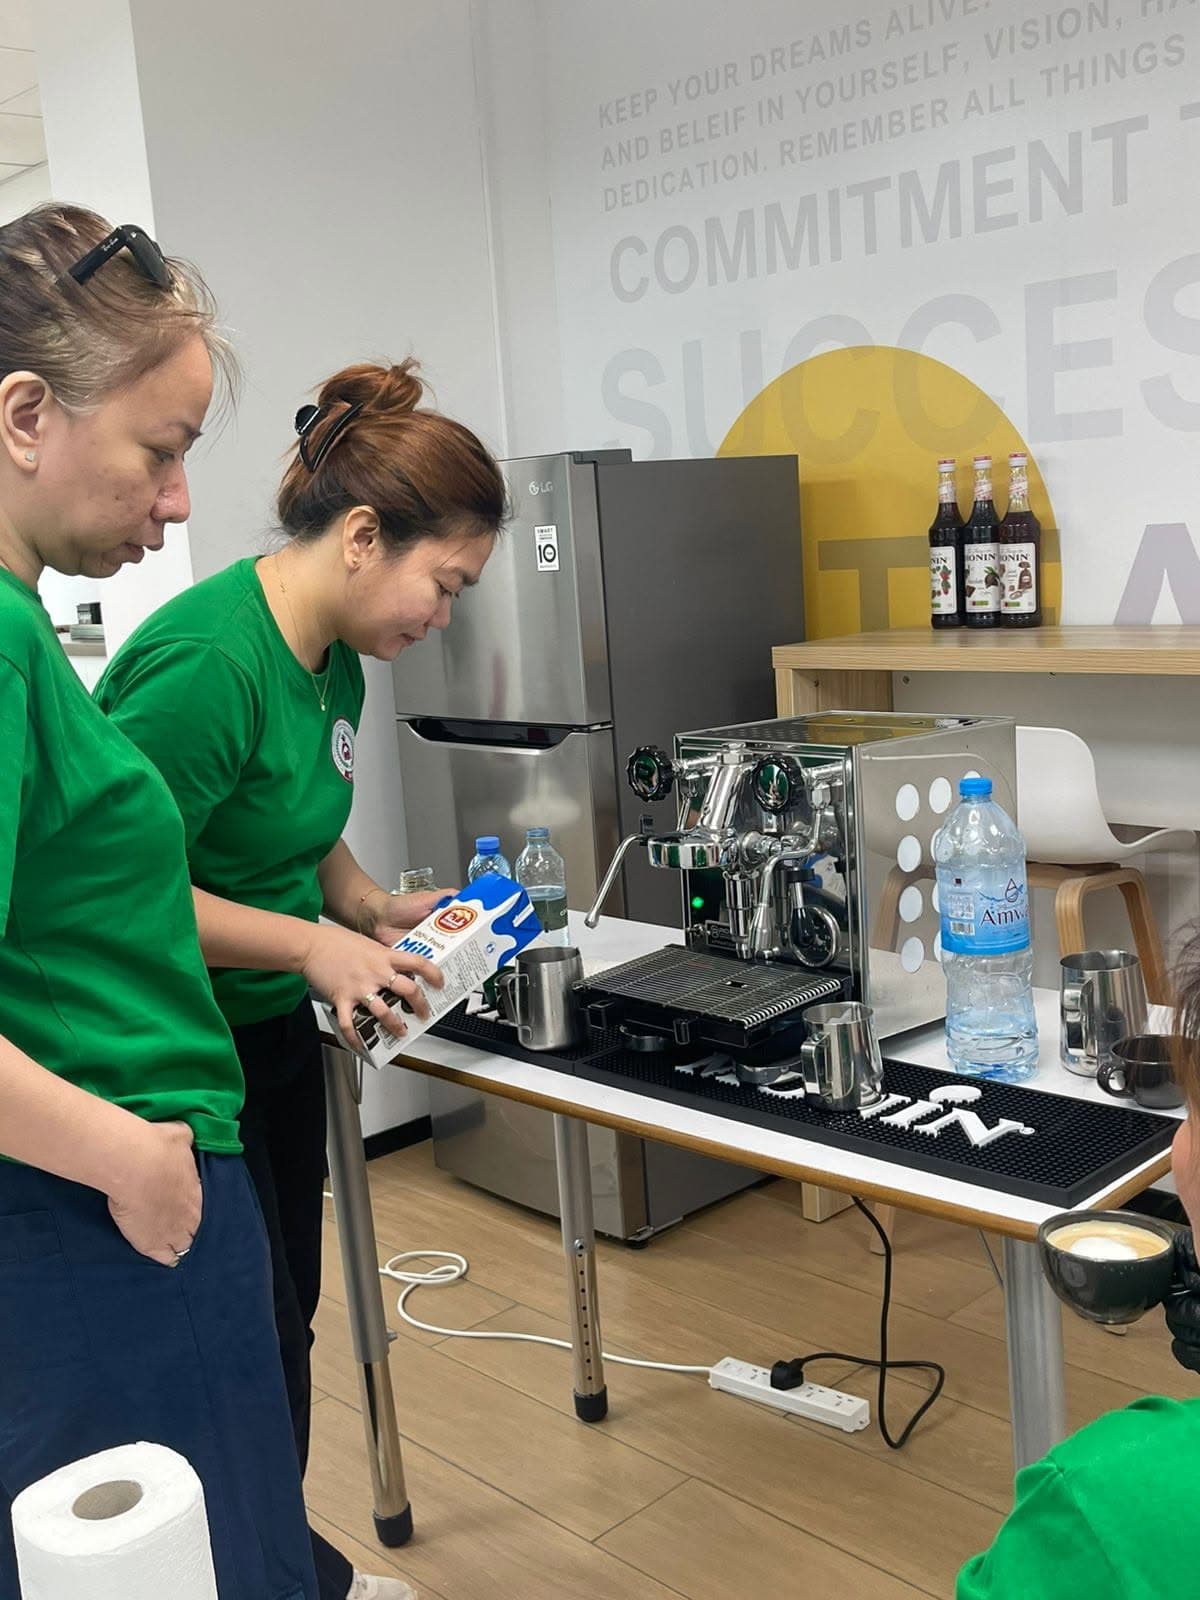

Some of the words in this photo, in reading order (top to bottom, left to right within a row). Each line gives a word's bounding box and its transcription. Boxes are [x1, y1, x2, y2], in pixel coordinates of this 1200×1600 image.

[599, 88, 658, 128] KEEP
[668, 62, 740, 105] YOUR
[750, 19, 873, 81] DREAMS
[601, 136, 649, 171] AND
[660, 106, 747, 154] BELEIF
[757, 95, 784, 127] IN
[796, 42, 970, 114] YOURSELF,
[984, 0, 1123, 61] VISION,
[604, 148, 768, 212] DEDICATION.
[780, 99, 949, 167] REMEMBER
[963, 78, 1026, 120] ALL
[1039, 34, 1186, 97] THINGS
[610, 113, 1150, 303] COMMITMENT
[537, 543, 557, 564] 10
